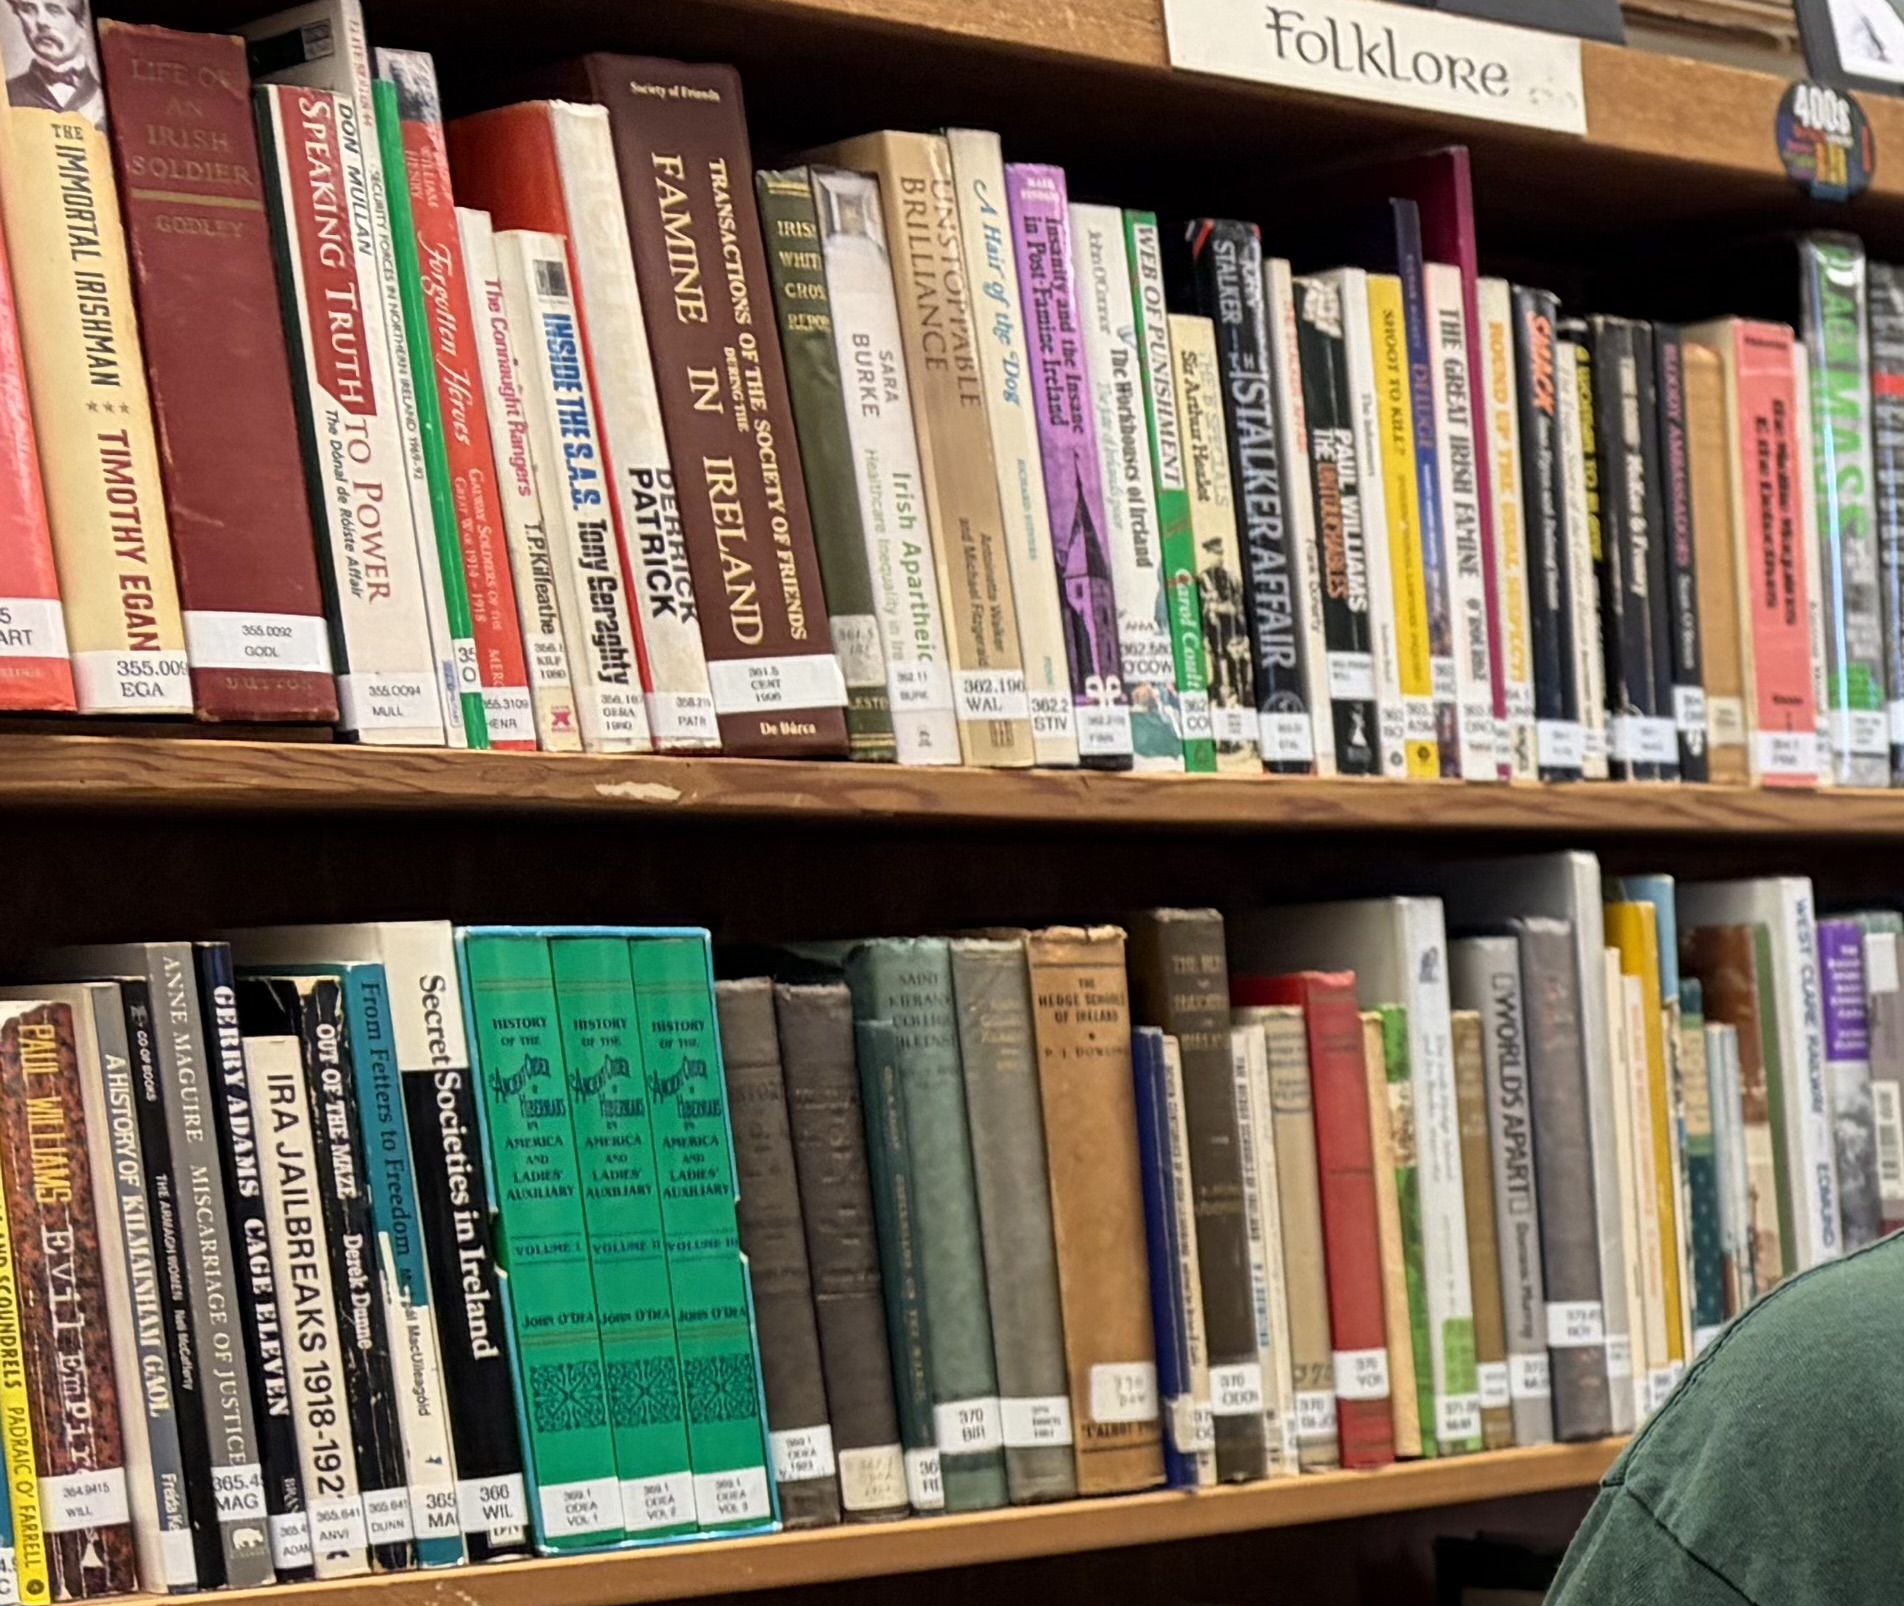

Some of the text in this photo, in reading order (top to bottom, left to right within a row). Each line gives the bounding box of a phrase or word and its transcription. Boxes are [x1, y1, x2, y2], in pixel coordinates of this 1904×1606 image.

[51, 123, 120, 386] THE IMMORTAL IRISHMAN
[131, 156, 253, 185] SOLDIER
[338, 103, 372, 255] DON MULLAN
[298, 97, 391, 603] SPEAKING TRUTH TO POWER
[900, 177, 948, 372] BRILLIANCE
[1023, 215, 1039, 235] in
[1042, 360, 1070, 427] Ireland
[1044, 215, 1085, 434] Insanity and the Insane
[1137, 227, 1183, 486] WEB OF PUNISHMENT
[1213, 239, 1243, 324] STALKER
[484, 280, 532, 497] The Connaught Rangers
[542, 312, 591, 441] INSIDE THE
[651, 152, 764, 647] FAMINE IN IRELAND
[709, 158, 808, 642] TRANSACTIONS OF THE SOCIETY FRIENDS
[852, 333, 880, 418] BURKE
[879, 349, 900, 404] SARA
[1230, 380, 1285, 541] STALKER
[1439, 308, 1480, 579] THE GREAT IRISH FAMINE
[97, 429, 161, 651] TIMOTHY EGAN
[629, 469, 676, 618] PATRICK
[892, 471, 916, 530] Irish
[120, 682, 164, 698] EGA
[1251, 545, 1297, 670] AFFAIR
[163, 955, 204, 1144] ANNE MAGUIRE
[493, 1016, 547, 1030] HISTORY
[1039, 993, 1081, 1008] HEDGE
[1054, 1010, 1072, 1024] OF
[17, 1024, 73, 1204] PAUL WILLIAMS
[214, 985, 260, 1198] GERRY ADAMS
[316, 1023, 357, 1201] OUT OF THE MAZE
[360, 981, 413, 1258] From Fetters to Freedom
[419, 975, 499, 1361] Secret Societies in Ireland
[505, 1134, 564, 1148] AMERICA
[585, 1134, 642, 1148] AMERICA
[662, 1135, 720, 1148] AMERICA
[1492, 991, 1532, 1198] WORLDS APART
[104, 1053, 171, 1418] A HISTORY OF KILMAINHAM GAOL
[267, 1074, 327, 1353] IRA JAILBREAKS
[343, 1233, 374, 1352] Derek Dunne
[190, 1165, 247, 1467] MISCARRIAGE OF JUSTICE
[244, 1218, 290, 1418] CAGE ELEVEN
[6, 1406, 41, 1568] PADRAIC FARRELL
[482, 1503, 513, 1521] WIL
